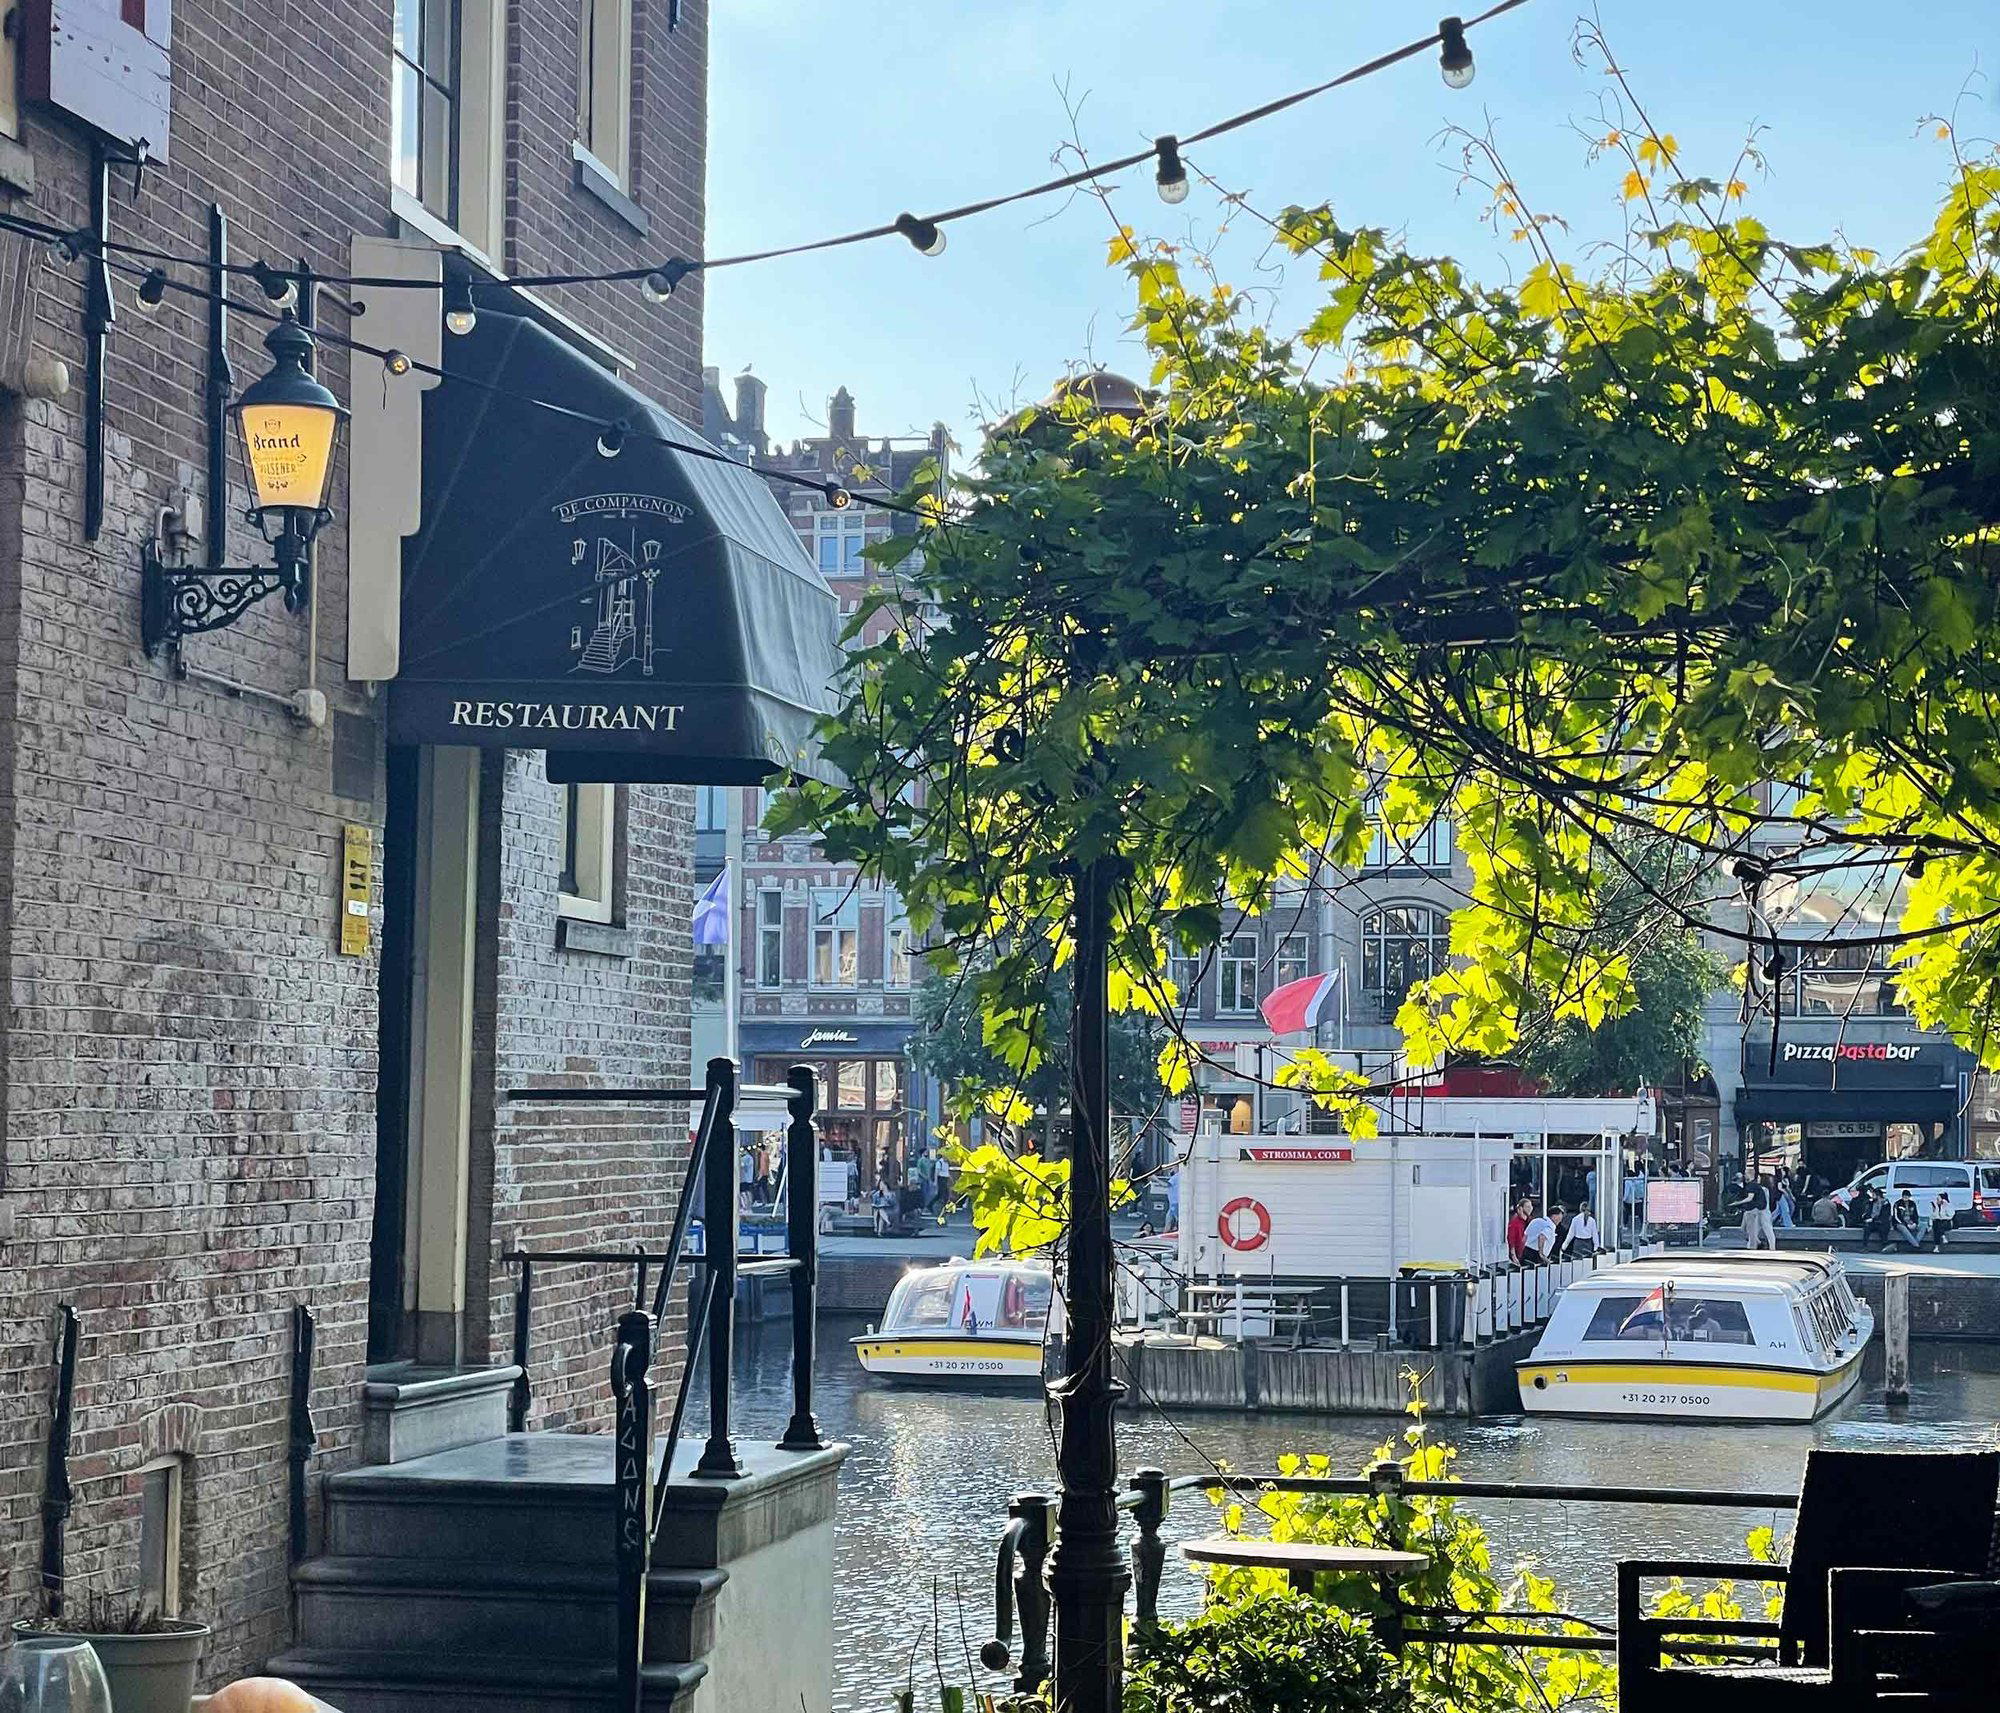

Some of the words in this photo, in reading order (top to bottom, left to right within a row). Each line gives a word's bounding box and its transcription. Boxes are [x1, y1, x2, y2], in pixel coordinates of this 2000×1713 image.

[253, 433, 300, 451] Brand
[560, 502, 580, 518] DE
[584, 496, 686, 518] COMPAGNON
[450, 701, 684, 731] RESTAURANT
[1769, 1341, 1786, 1349] AH
[960, 1362, 975, 1370] 217
[978, 1362, 1004, 1370] 0500
[1622, 1393, 1639, 1402] +31
[1642, 1394, 1656, 1403] 20
[1660, 1395, 1677, 1404] 217
[1680, 1396, 1710, 1405] 0500
